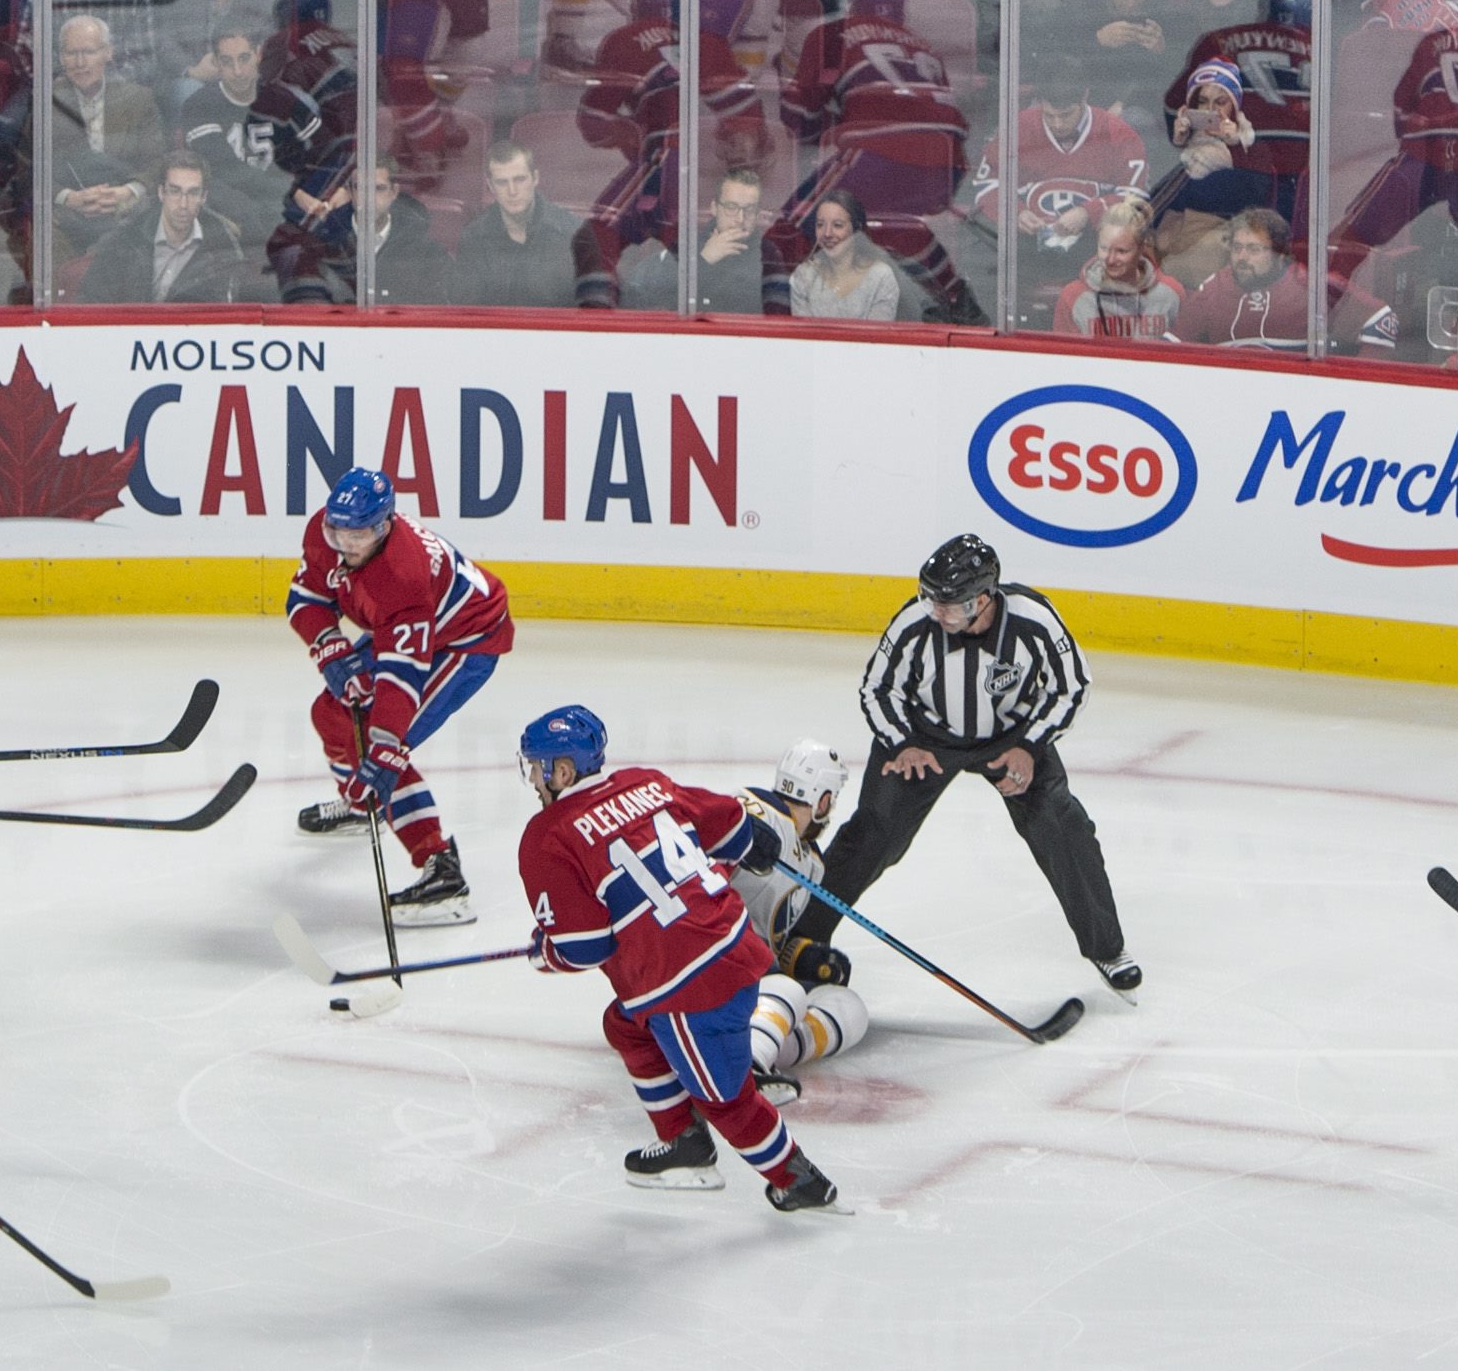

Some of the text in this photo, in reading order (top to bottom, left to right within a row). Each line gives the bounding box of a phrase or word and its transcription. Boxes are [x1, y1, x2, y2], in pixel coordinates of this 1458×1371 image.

[227, 122, 275, 172] 15
[1128, 159, 1145, 186] 7
[129, 340, 326, 371] MOLSON
[124, 383, 738, 528] CANADIAN
[1006, 424, 1164, 499] Esso
[393, 621, 430, 655] 27
[994, 669, 1018, 689] NHL
[29, 750, 98, 761] NEXUS
[781, 780, 794, 795] 90
[572, 781, 674, 847] PLEKANEC
[607, 807, 729, 929] 14
